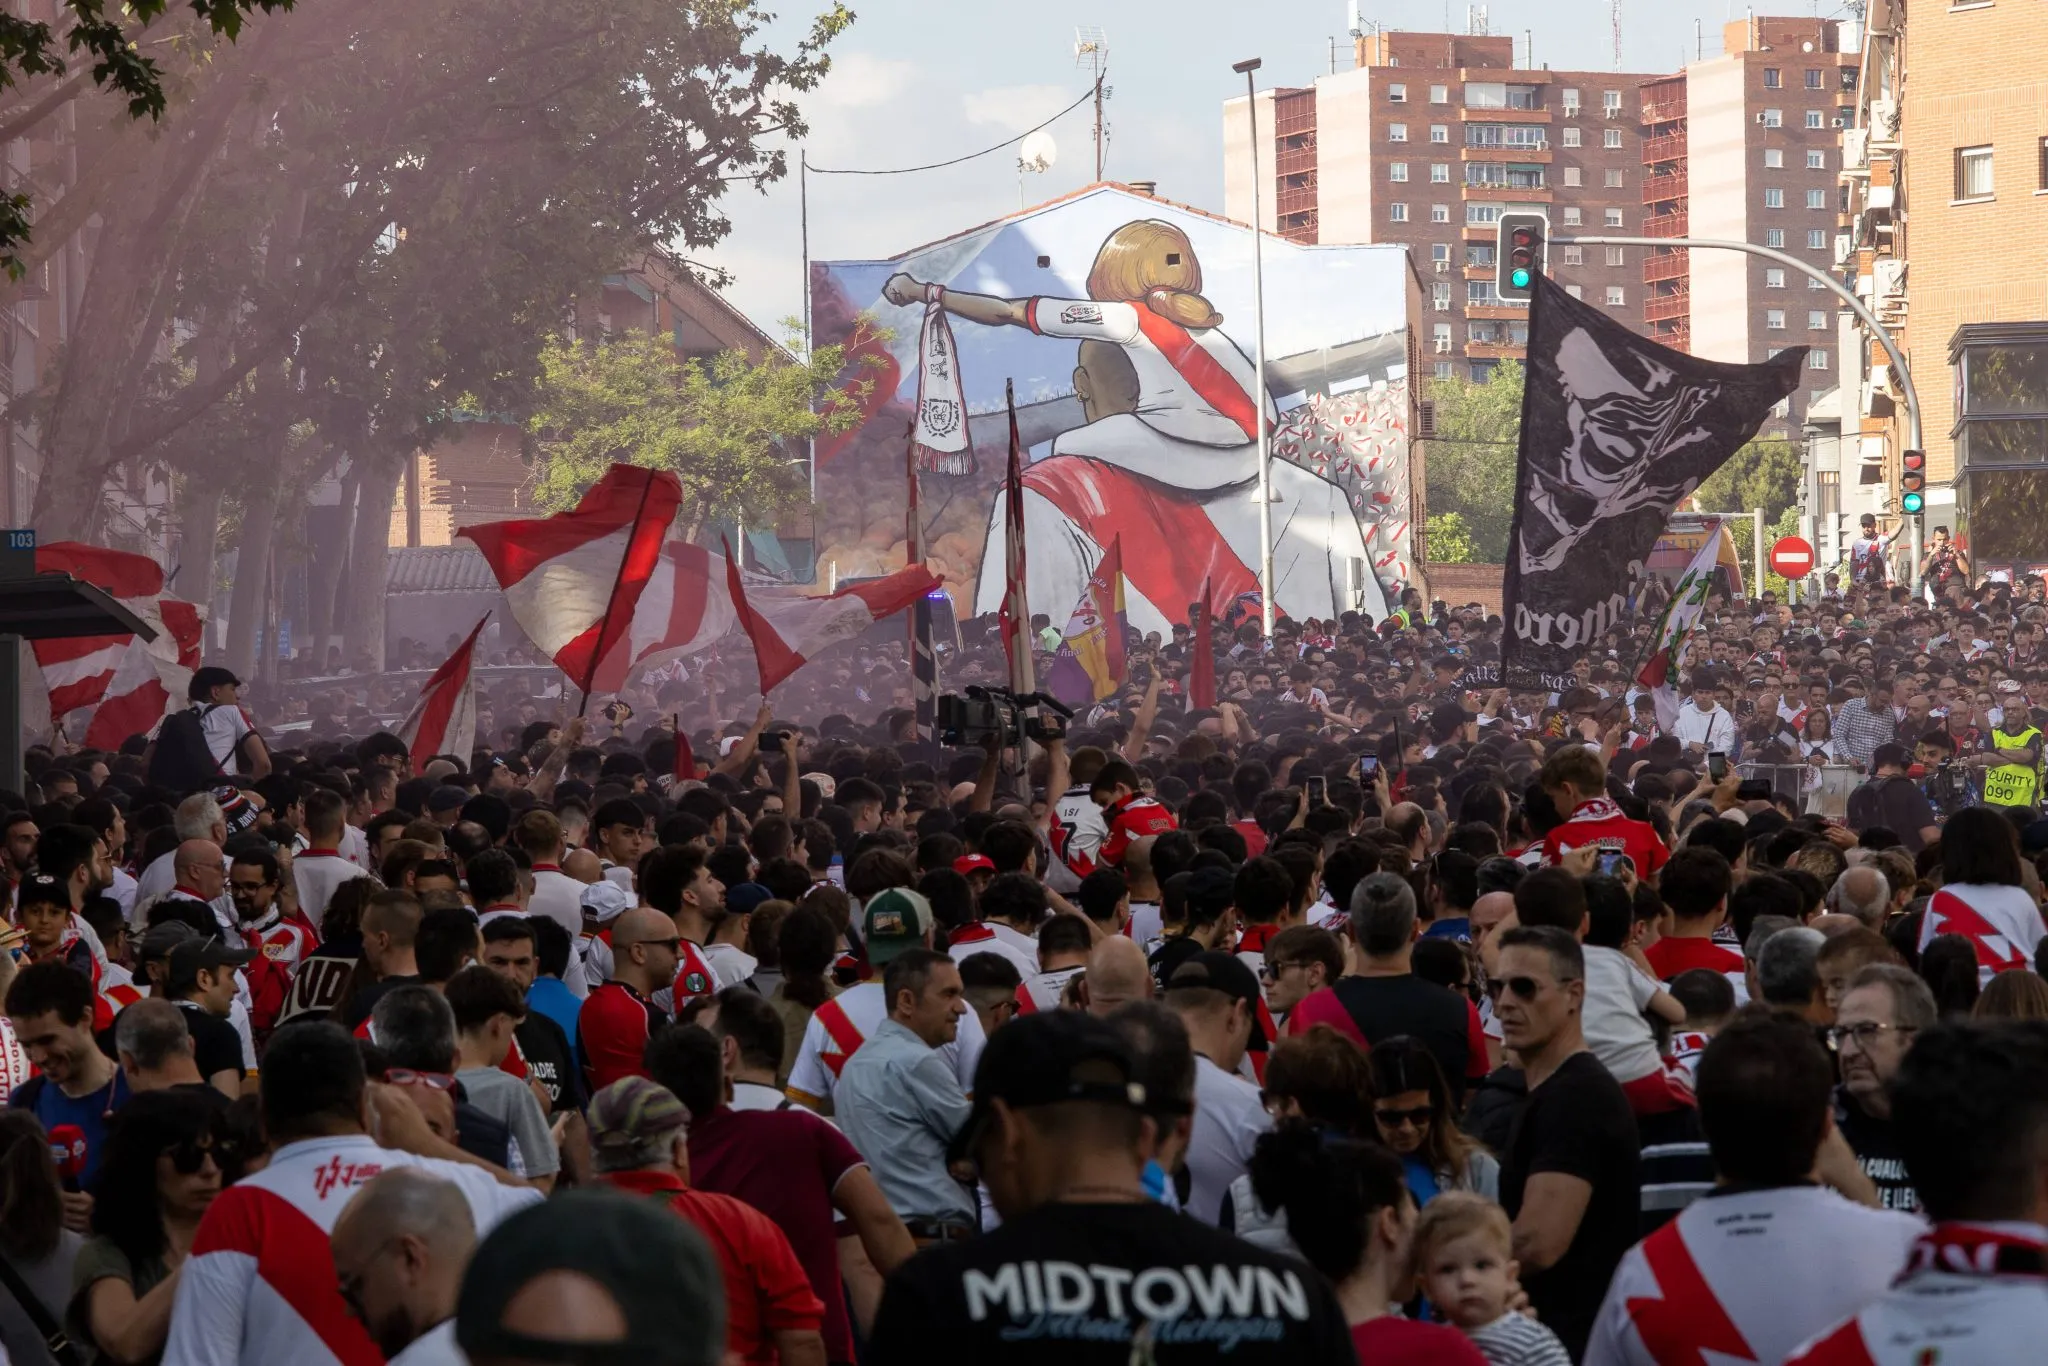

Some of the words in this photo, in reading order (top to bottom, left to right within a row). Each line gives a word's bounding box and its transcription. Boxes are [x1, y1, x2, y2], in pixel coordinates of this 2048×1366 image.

[10, 532, 33, 547] 103
[1986, 784, 2014, 800] 090
[1060, 822, 1077, 865] 7
[962, 1260, 1311, 1323] MIDTOWN
